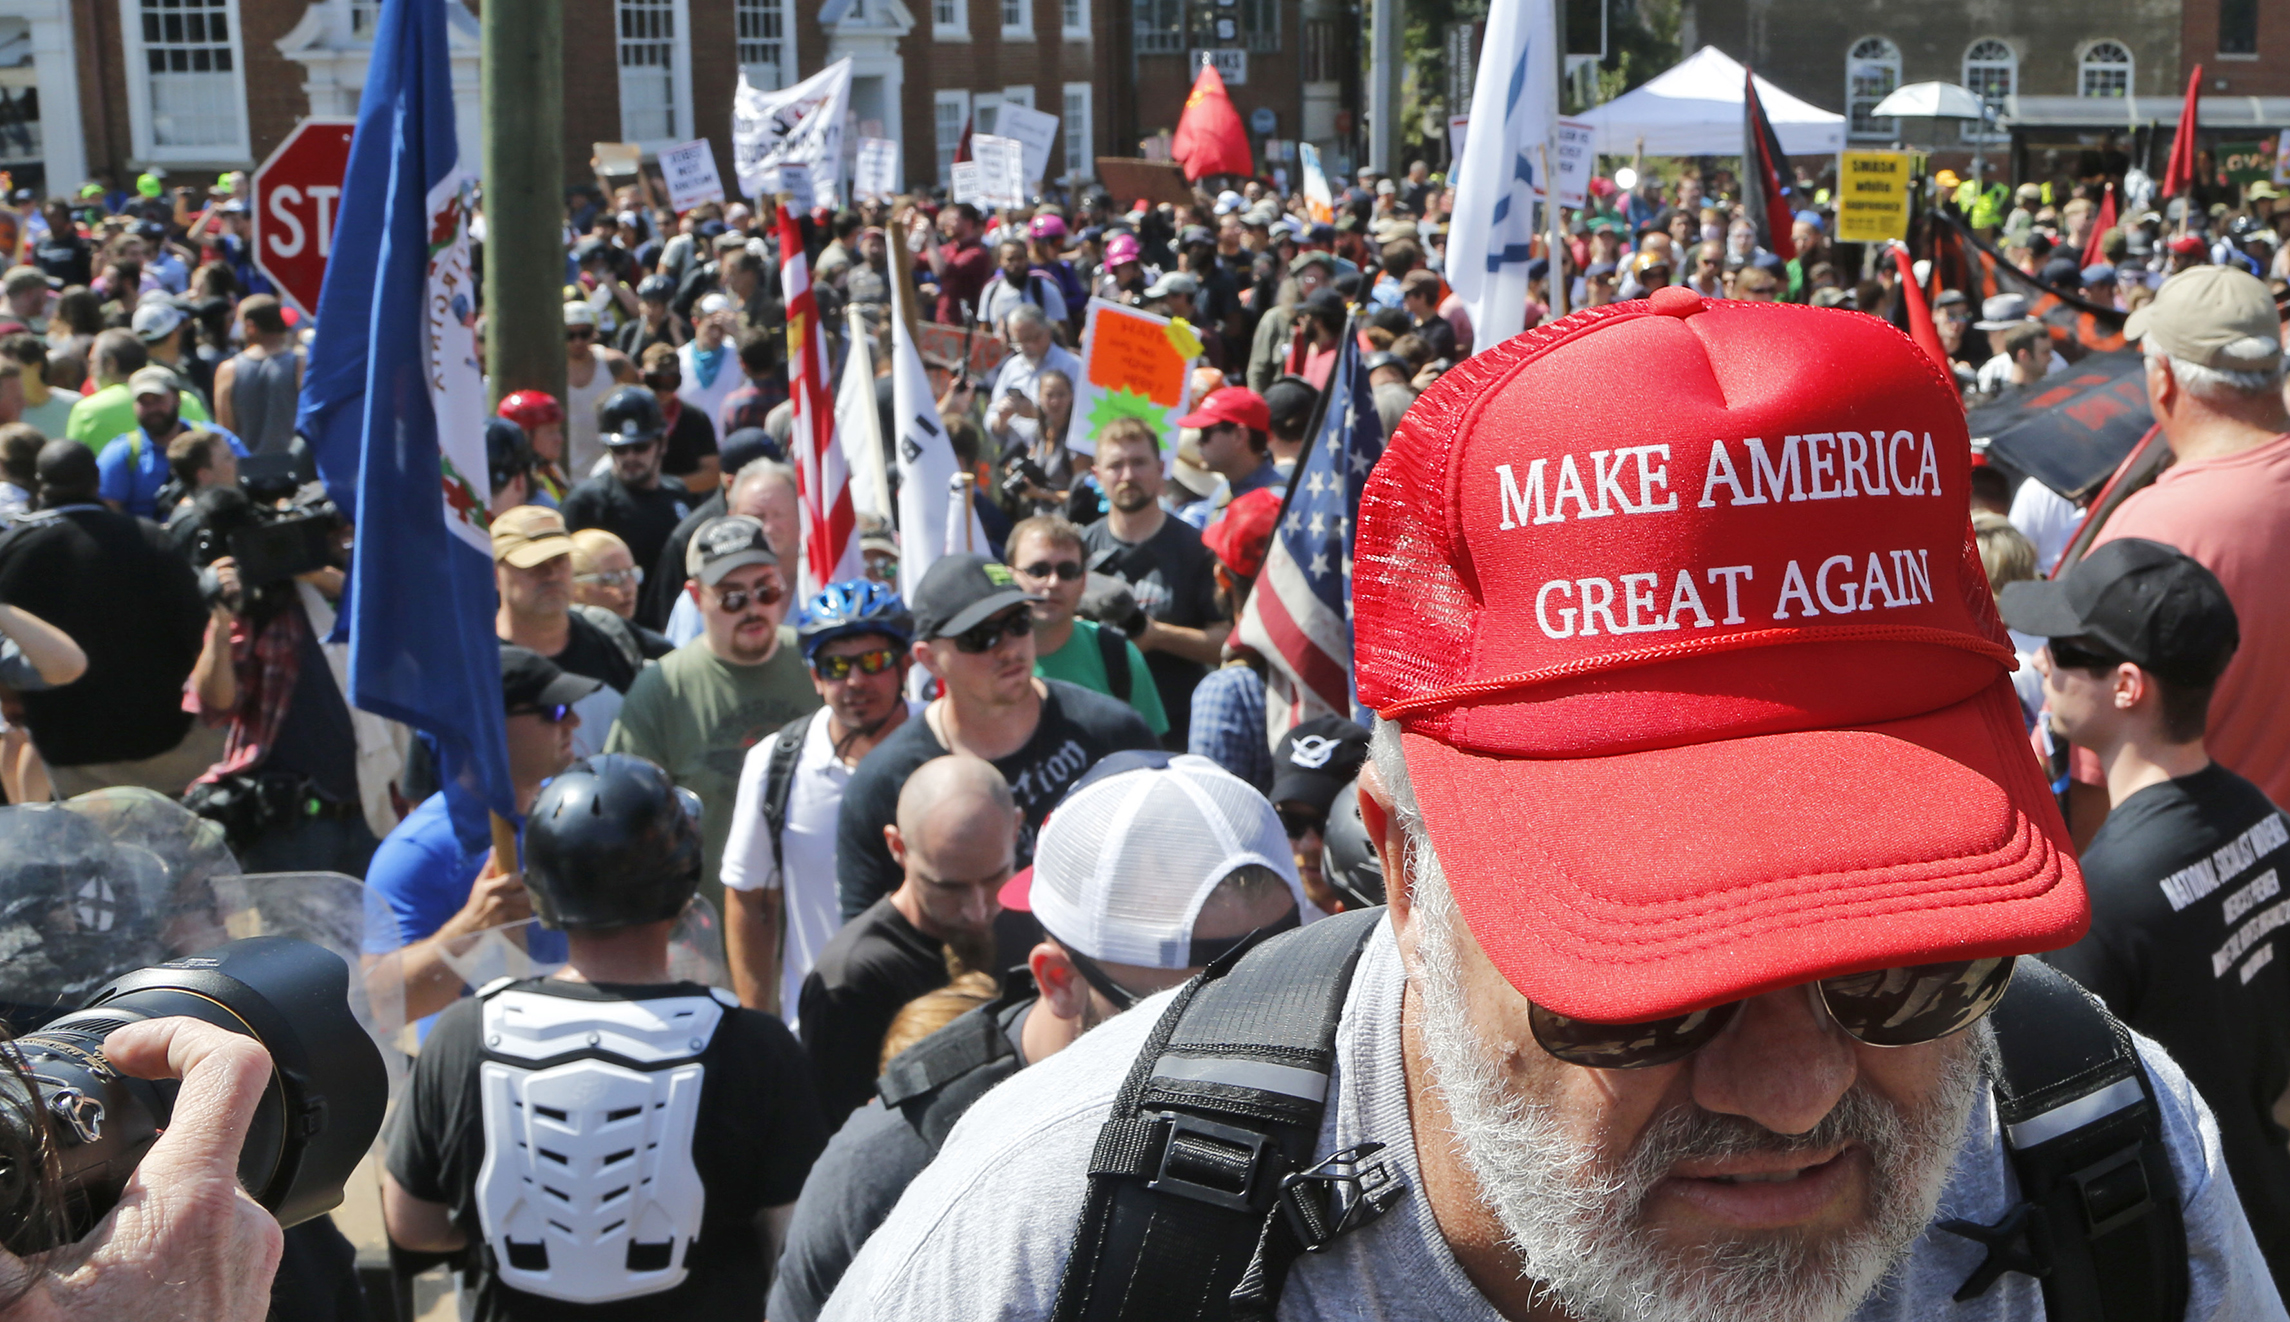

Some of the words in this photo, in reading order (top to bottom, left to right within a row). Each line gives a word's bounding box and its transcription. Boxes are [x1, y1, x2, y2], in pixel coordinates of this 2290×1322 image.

[1852, 159, 1897, 173] SMASH
[267, 184, 341, 259] ST
[1495, 443, 1679, 531] MAKE
[1697, 430, 1942, 508] AMERICA
[1534, 565, 1753, 640] GREAT
[1772, 549, 1934, 620] AGAIN
[1009, 739, 1087, 805] tion
[2159, 857, 2221, 912] NATIONAL
